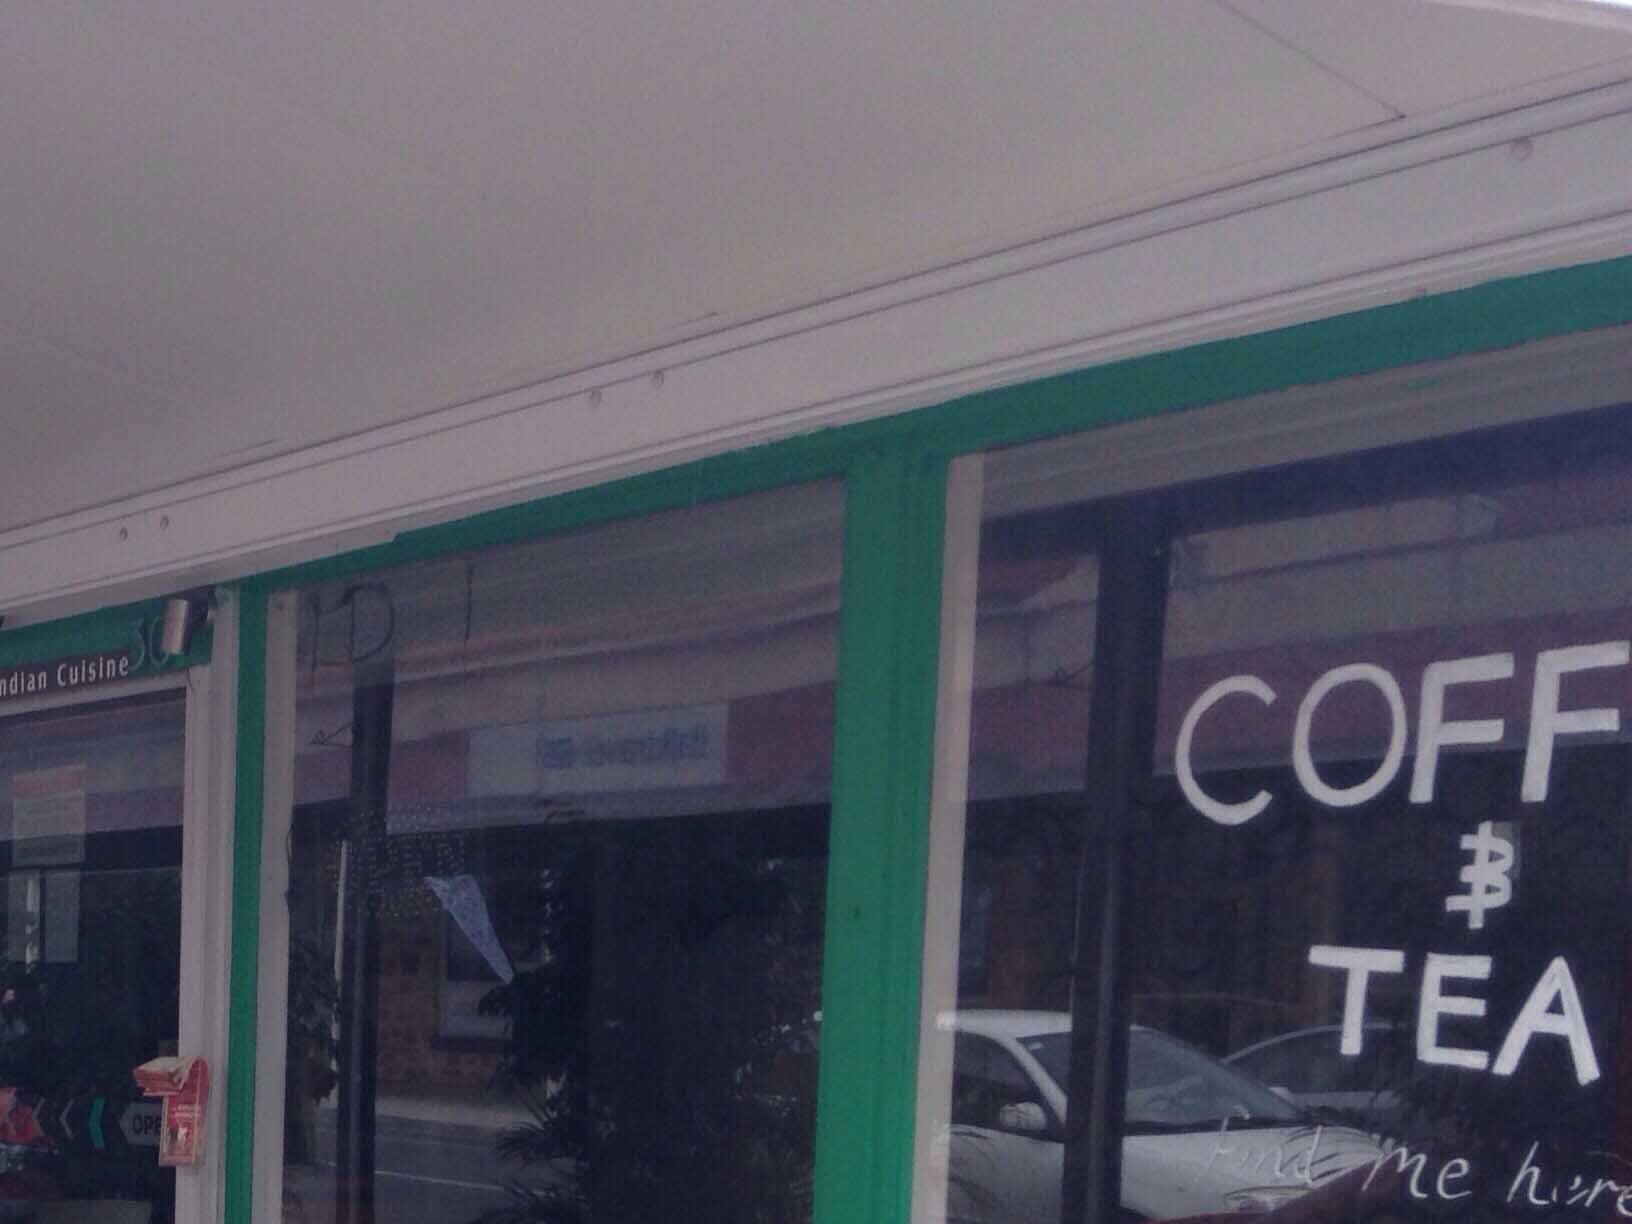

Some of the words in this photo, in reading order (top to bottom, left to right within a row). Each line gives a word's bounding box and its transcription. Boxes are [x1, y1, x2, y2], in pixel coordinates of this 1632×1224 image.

[56, 655, 129, 688] Cuisine
[1309, 945, 1600, 1086] TEA
[1362, 1143, 1472, 1201] me
